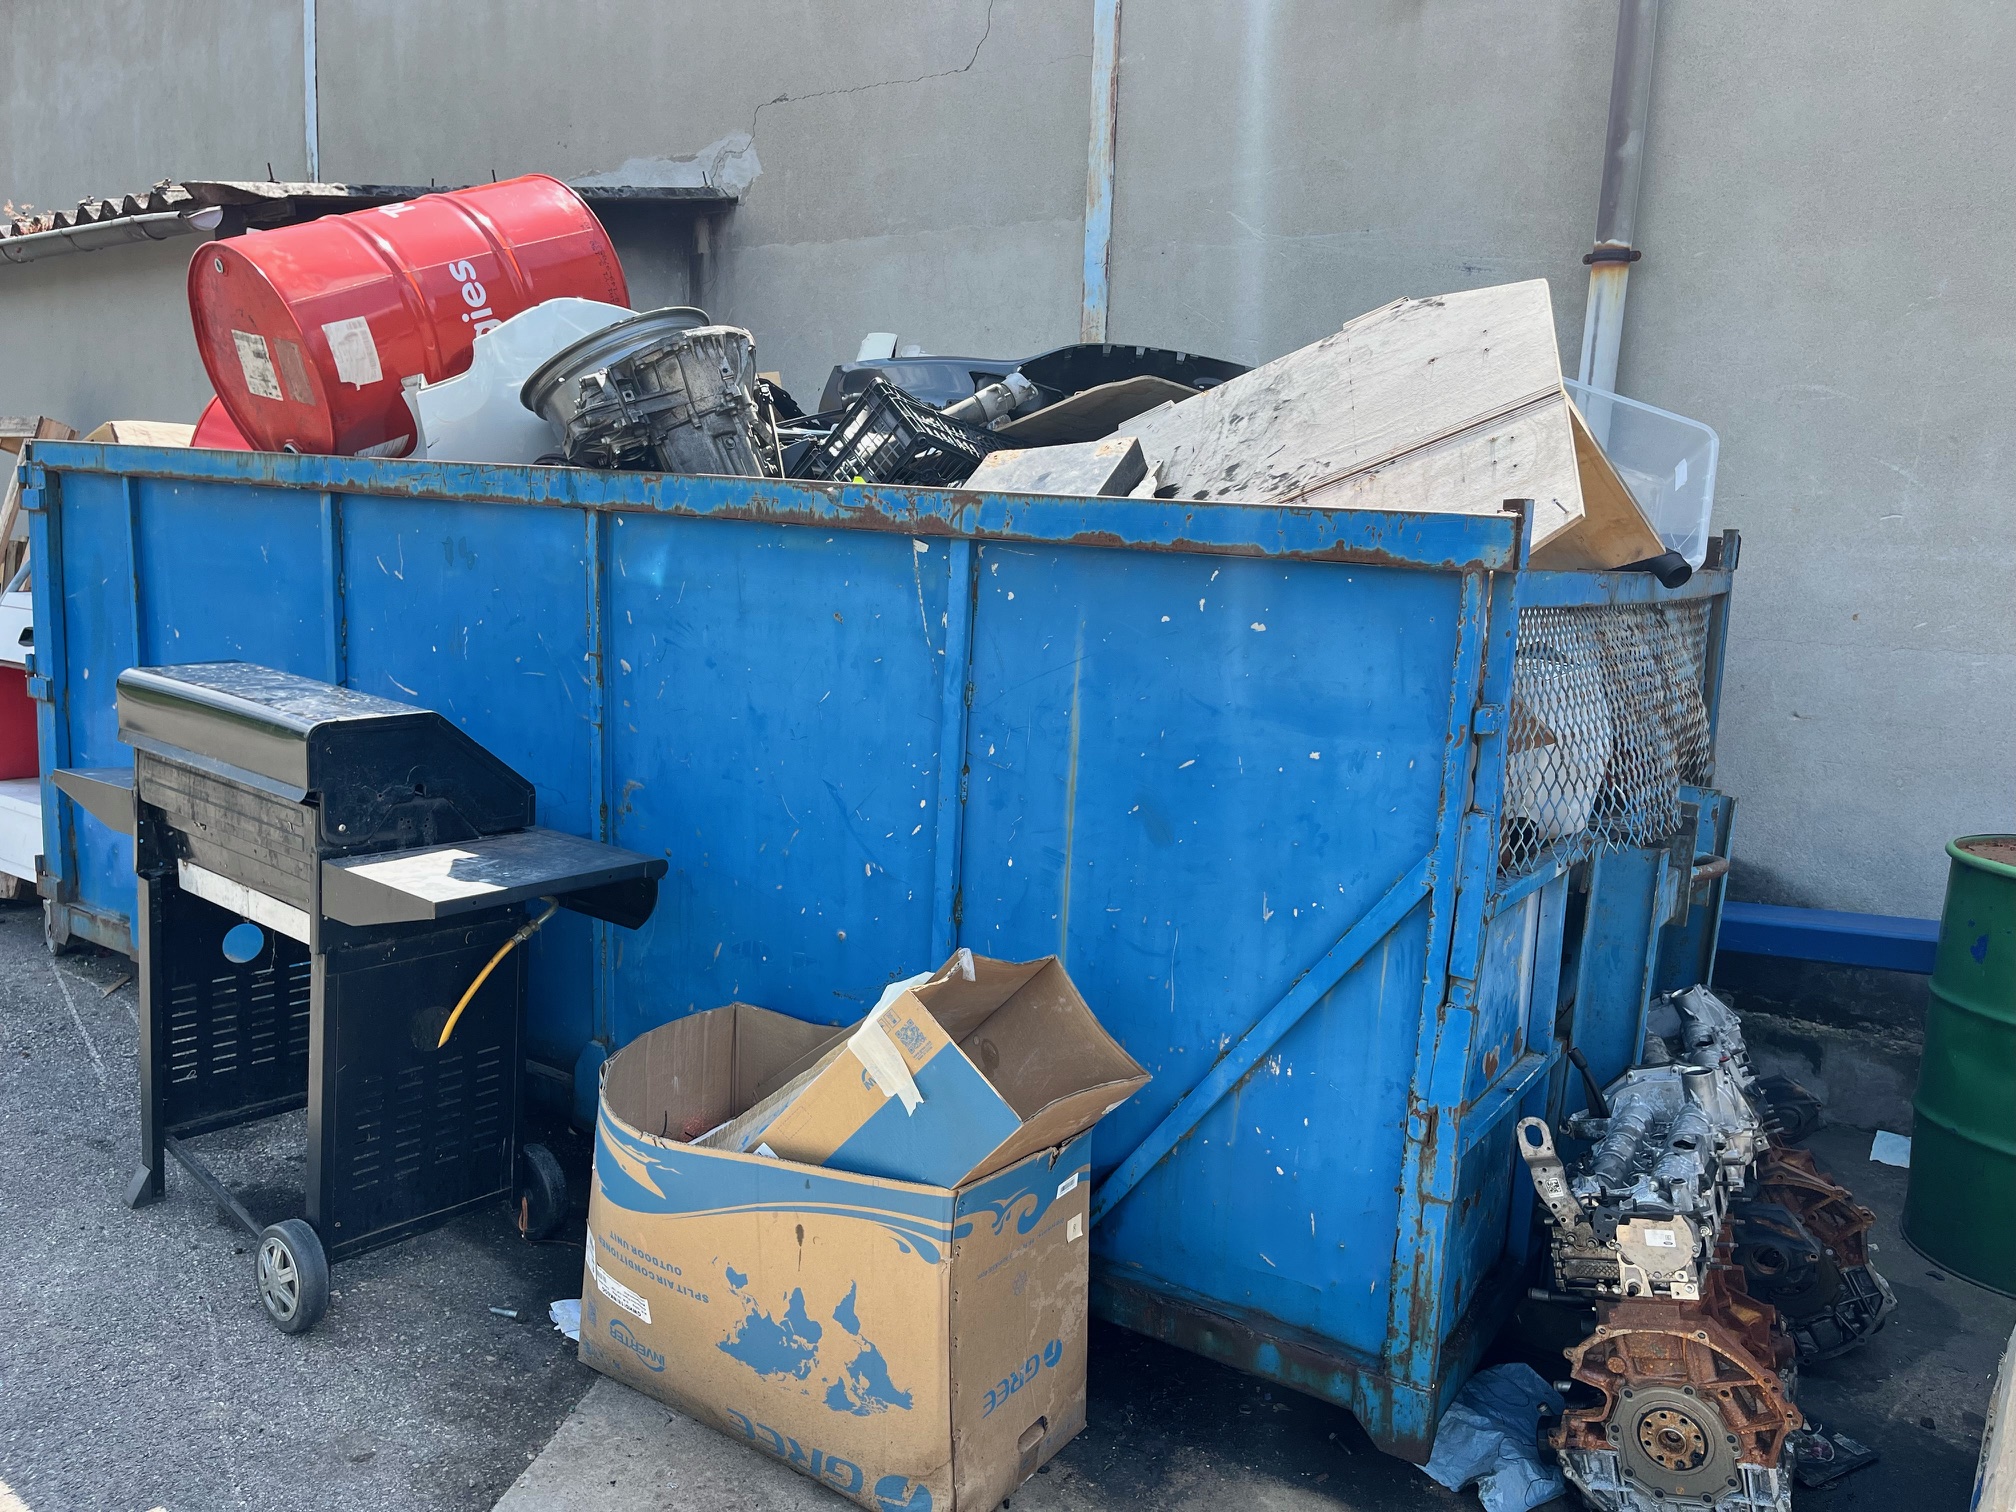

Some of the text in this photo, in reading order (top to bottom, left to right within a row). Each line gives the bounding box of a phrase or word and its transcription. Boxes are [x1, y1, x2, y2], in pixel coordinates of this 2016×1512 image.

[598, 1234, 655, 1280] CONDITIONER
[610, 1231, 682, 1276] OUTDOOR UNIT
[656, 1276, 674, 1289] AIR
[676, 1287, 709, 1304] SPLIT
[609, 1326, 666, 1366] INVERTER
[981, 1353, 1041, 1419] GREE
[726, 1407, 864, 1494] GREE
